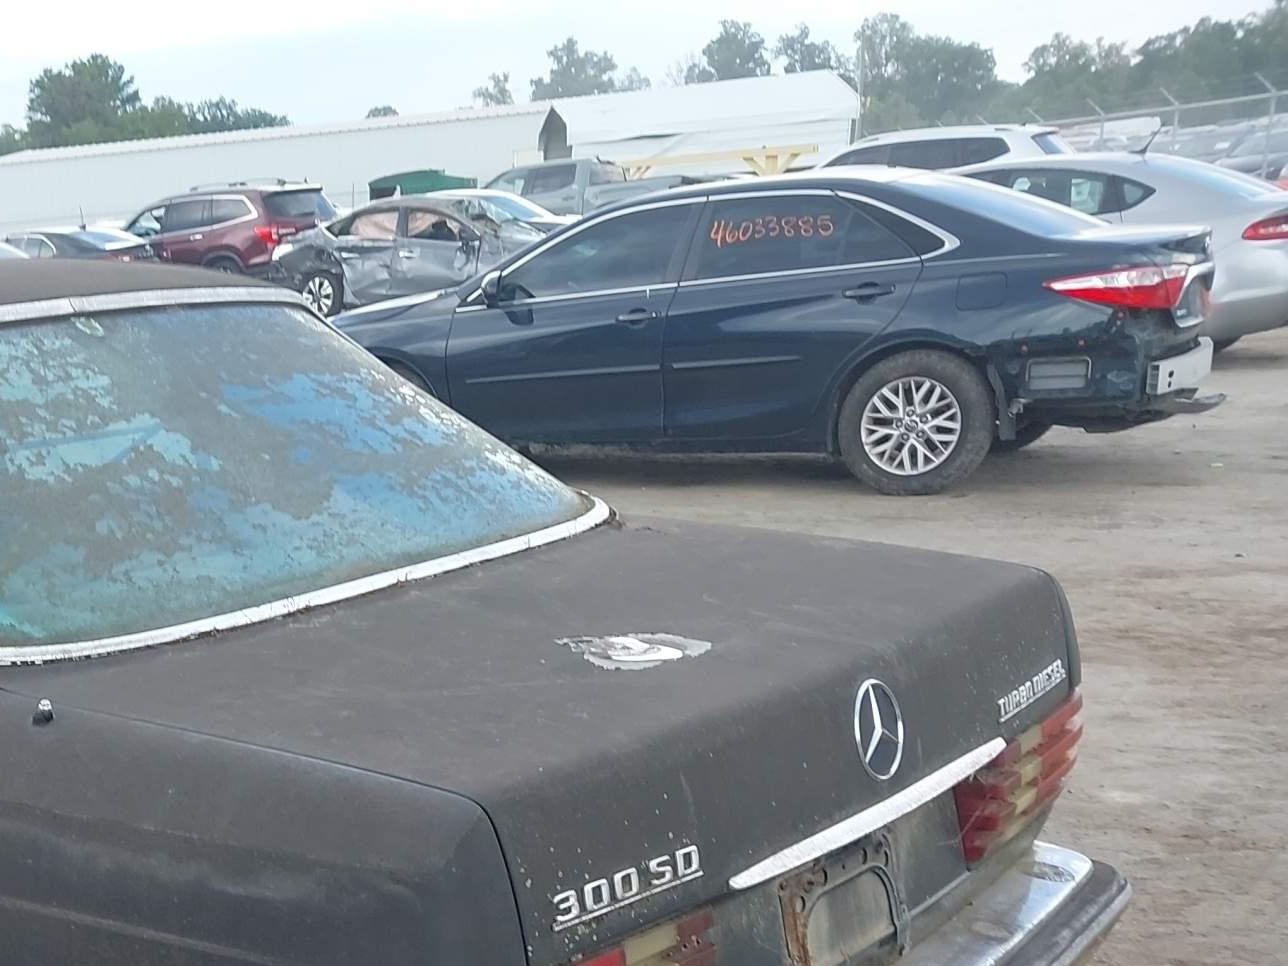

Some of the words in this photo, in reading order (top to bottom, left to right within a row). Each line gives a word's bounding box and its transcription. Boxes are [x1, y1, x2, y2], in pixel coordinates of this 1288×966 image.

[710, 214, 834, 249] 46033885
[553, 866, 640, 922] 300
[648, 844, 700, 886] SD
